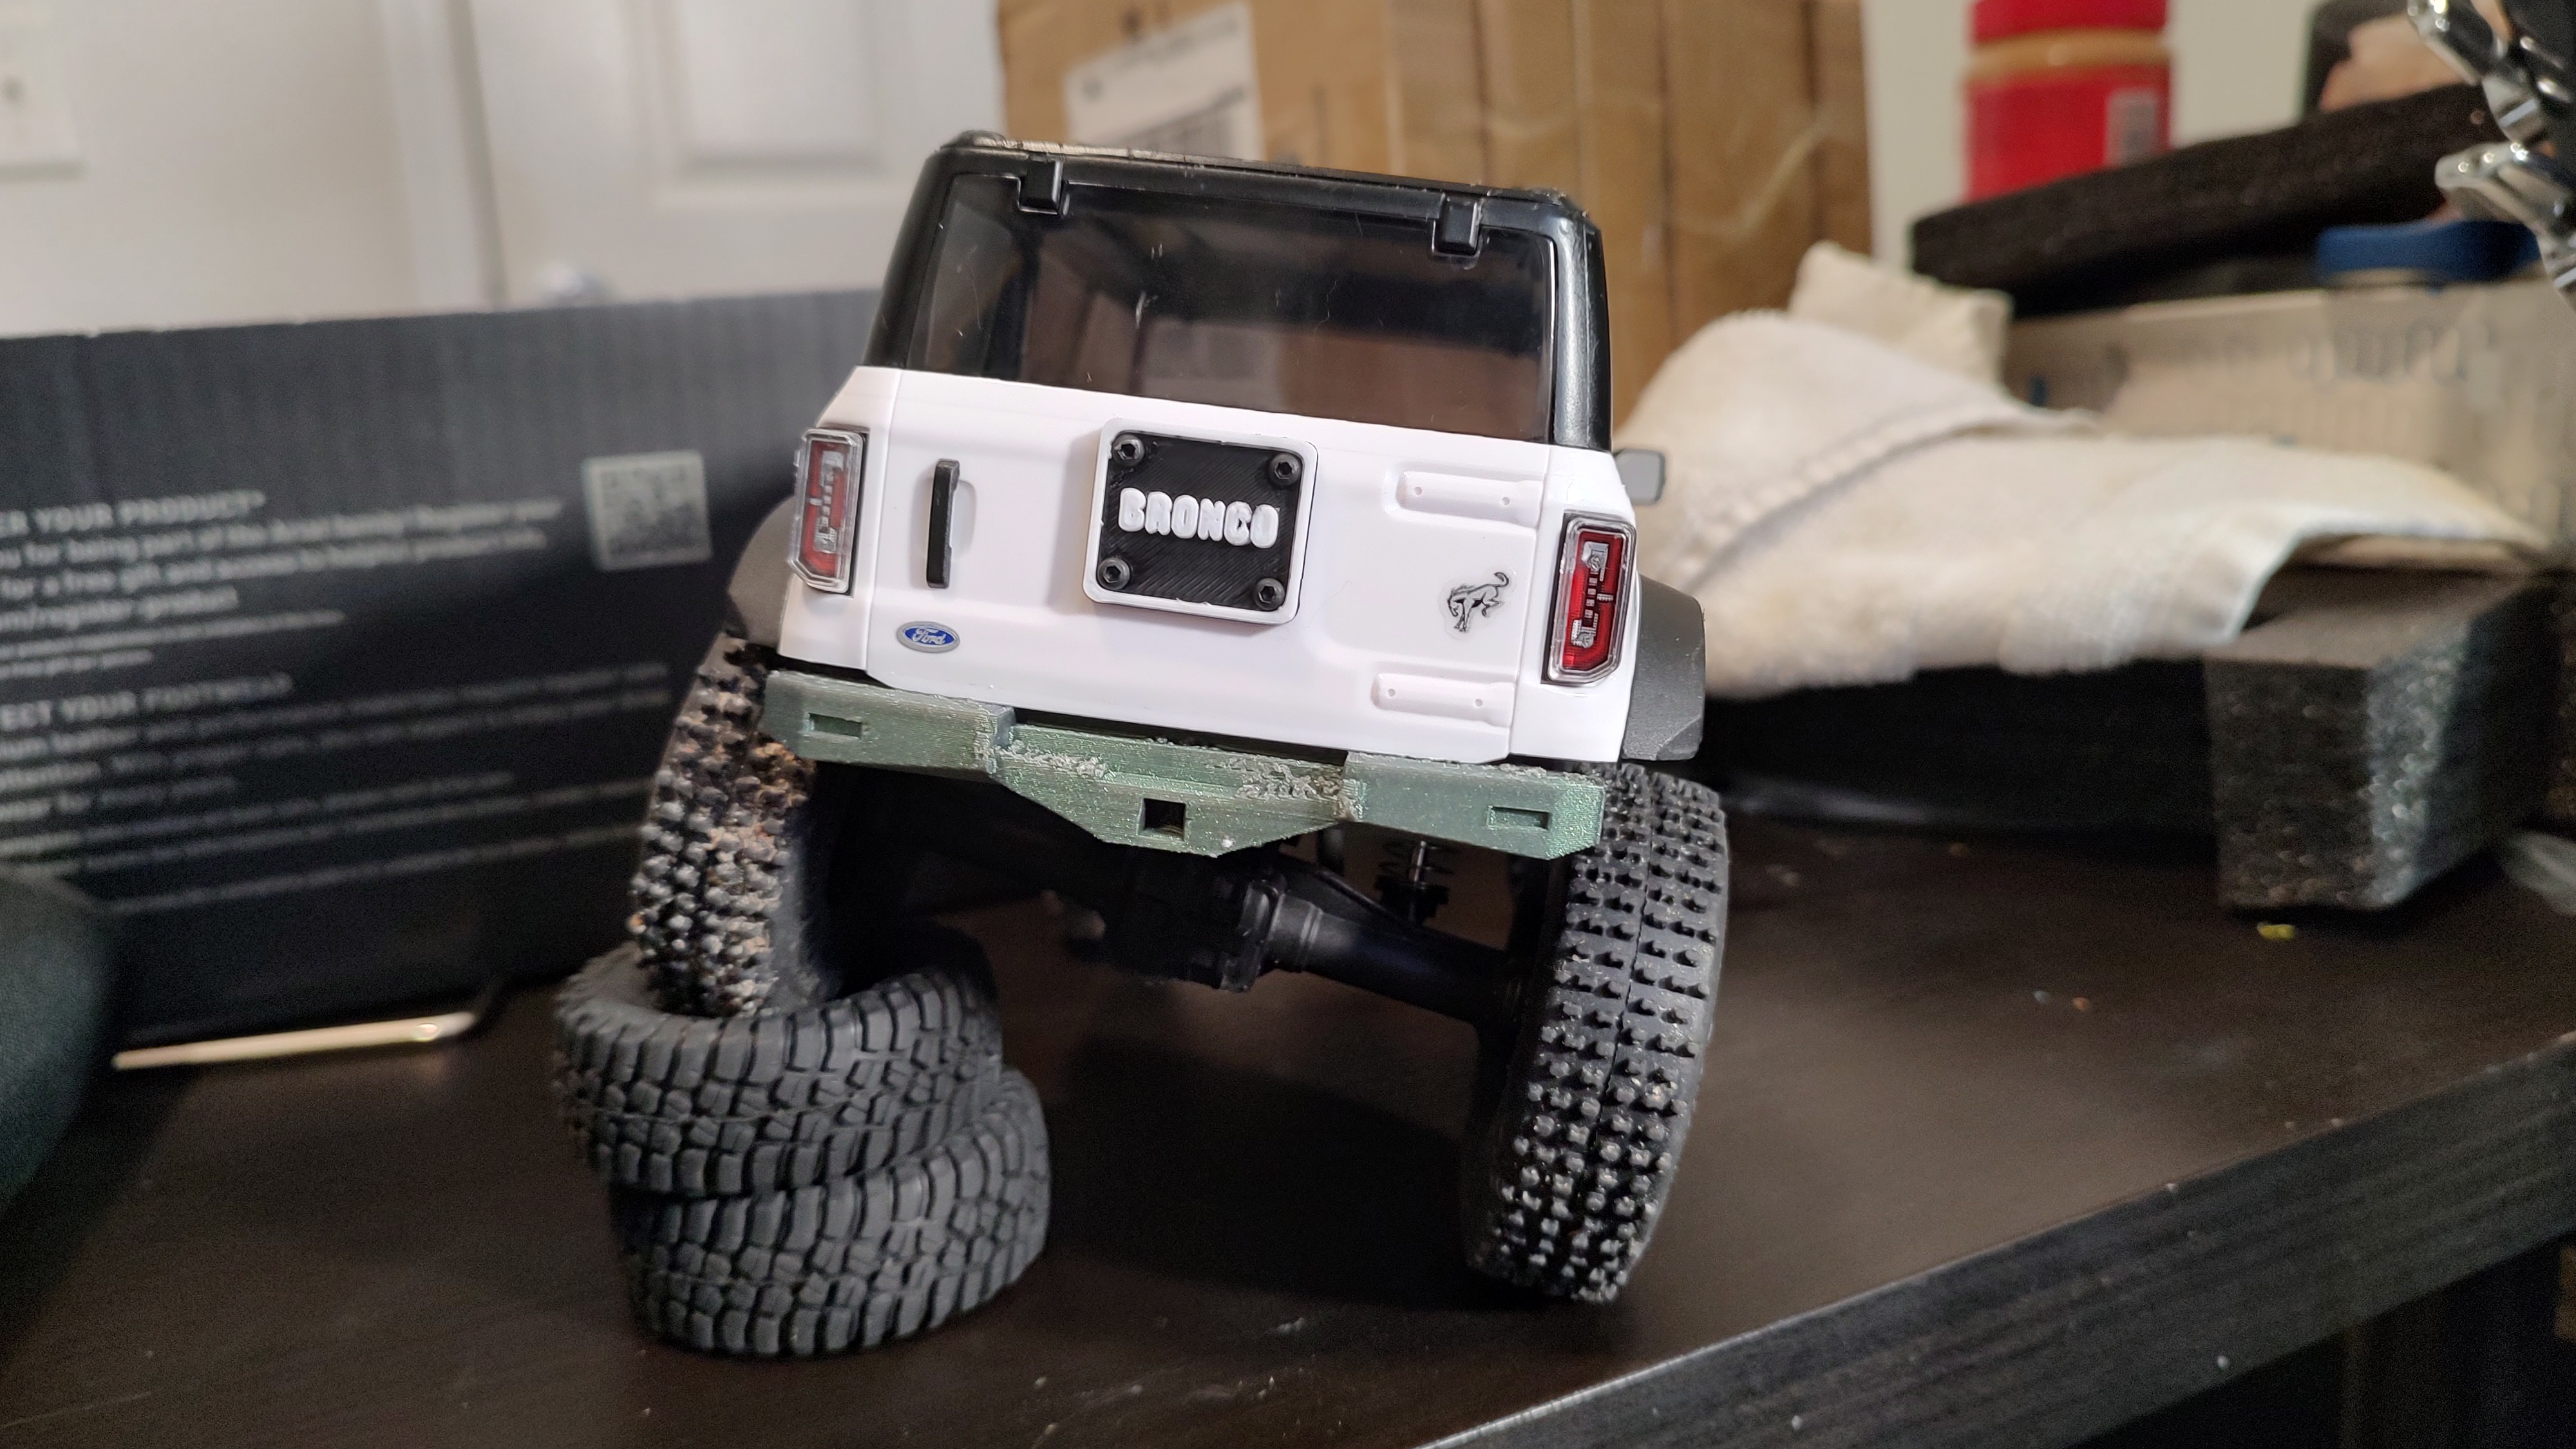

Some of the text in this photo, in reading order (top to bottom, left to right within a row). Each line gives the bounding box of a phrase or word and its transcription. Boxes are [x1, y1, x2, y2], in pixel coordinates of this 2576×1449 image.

[33, 503, 113, 533] YOUR
[1118, 488, 1279, 548] BRONCO
[24, 541, 61, 566] for
[1, 577, 34, 601] for
[912, 627, 947, 645] Ford
[1, 700, 51, 732] ECT
[61, 691, 136, 721] YOUR
